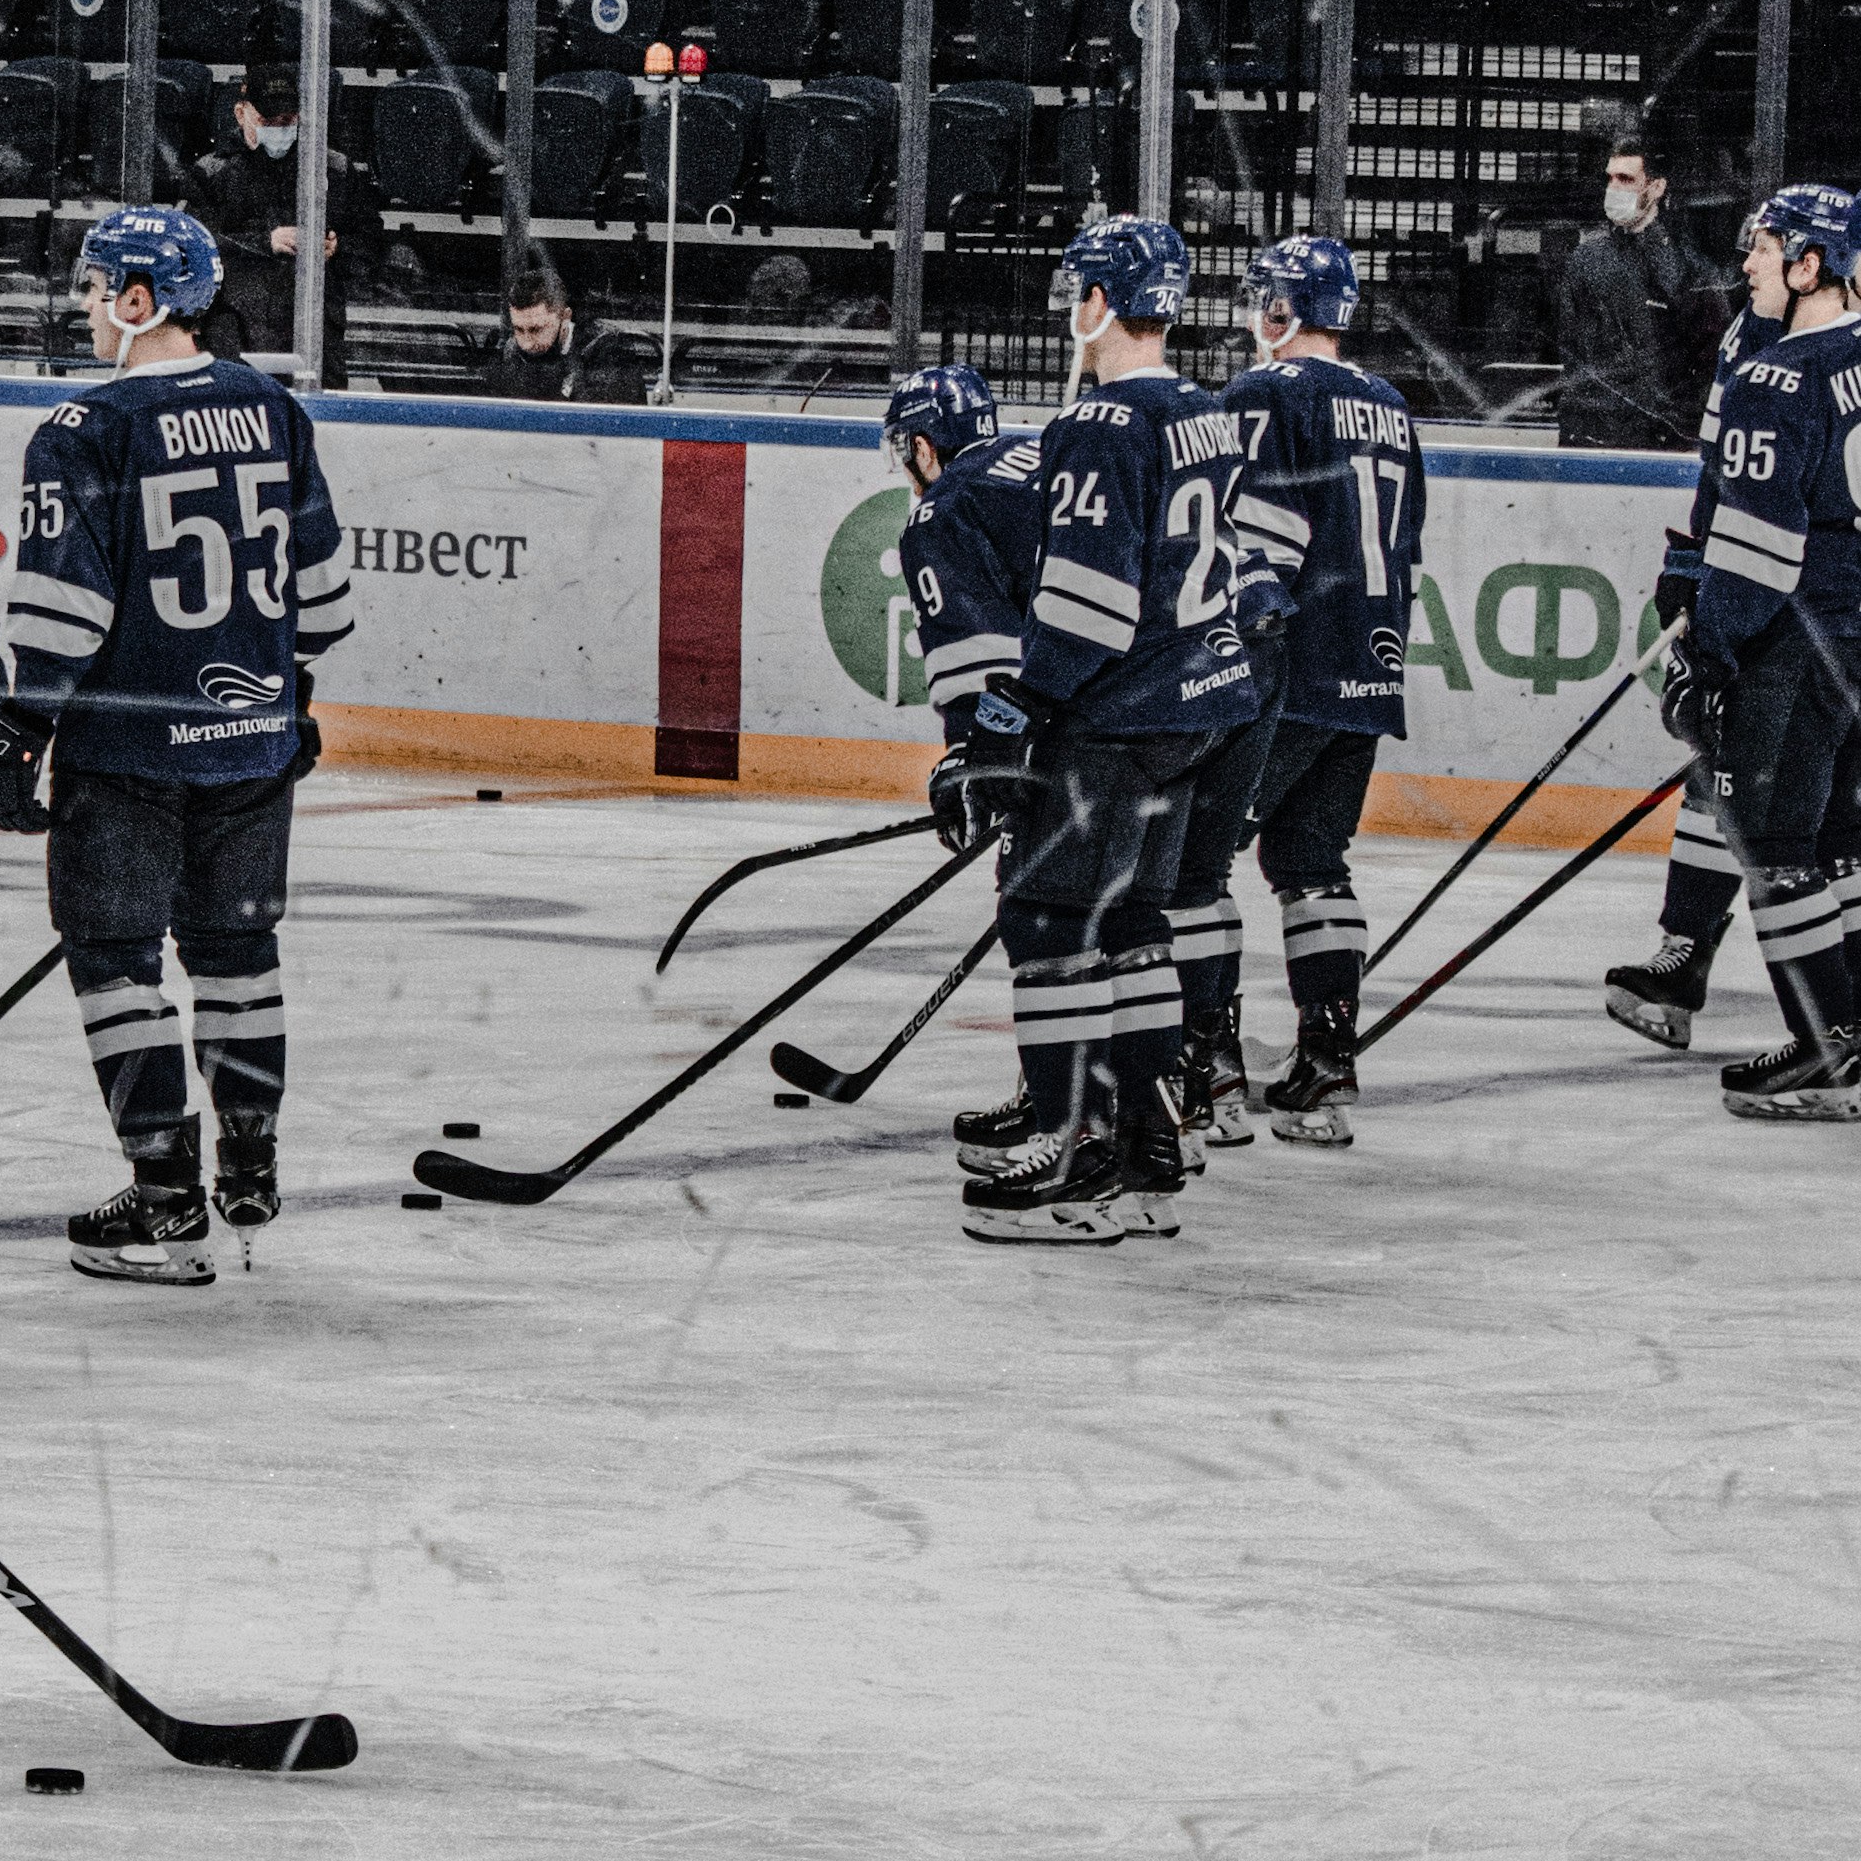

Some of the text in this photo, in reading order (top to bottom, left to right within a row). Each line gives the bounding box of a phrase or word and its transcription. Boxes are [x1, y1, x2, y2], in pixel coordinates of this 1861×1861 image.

[1746, 361, 1805, 395] ВТБ
[157, 403, 274, 461] BOIKOV
[1074, 399, 1135, 428] ВТБ
[1720, 426, 1779, 483] 95
[1048, 469, 1110, 528] 24
[139, 461, 292, 633] 55
